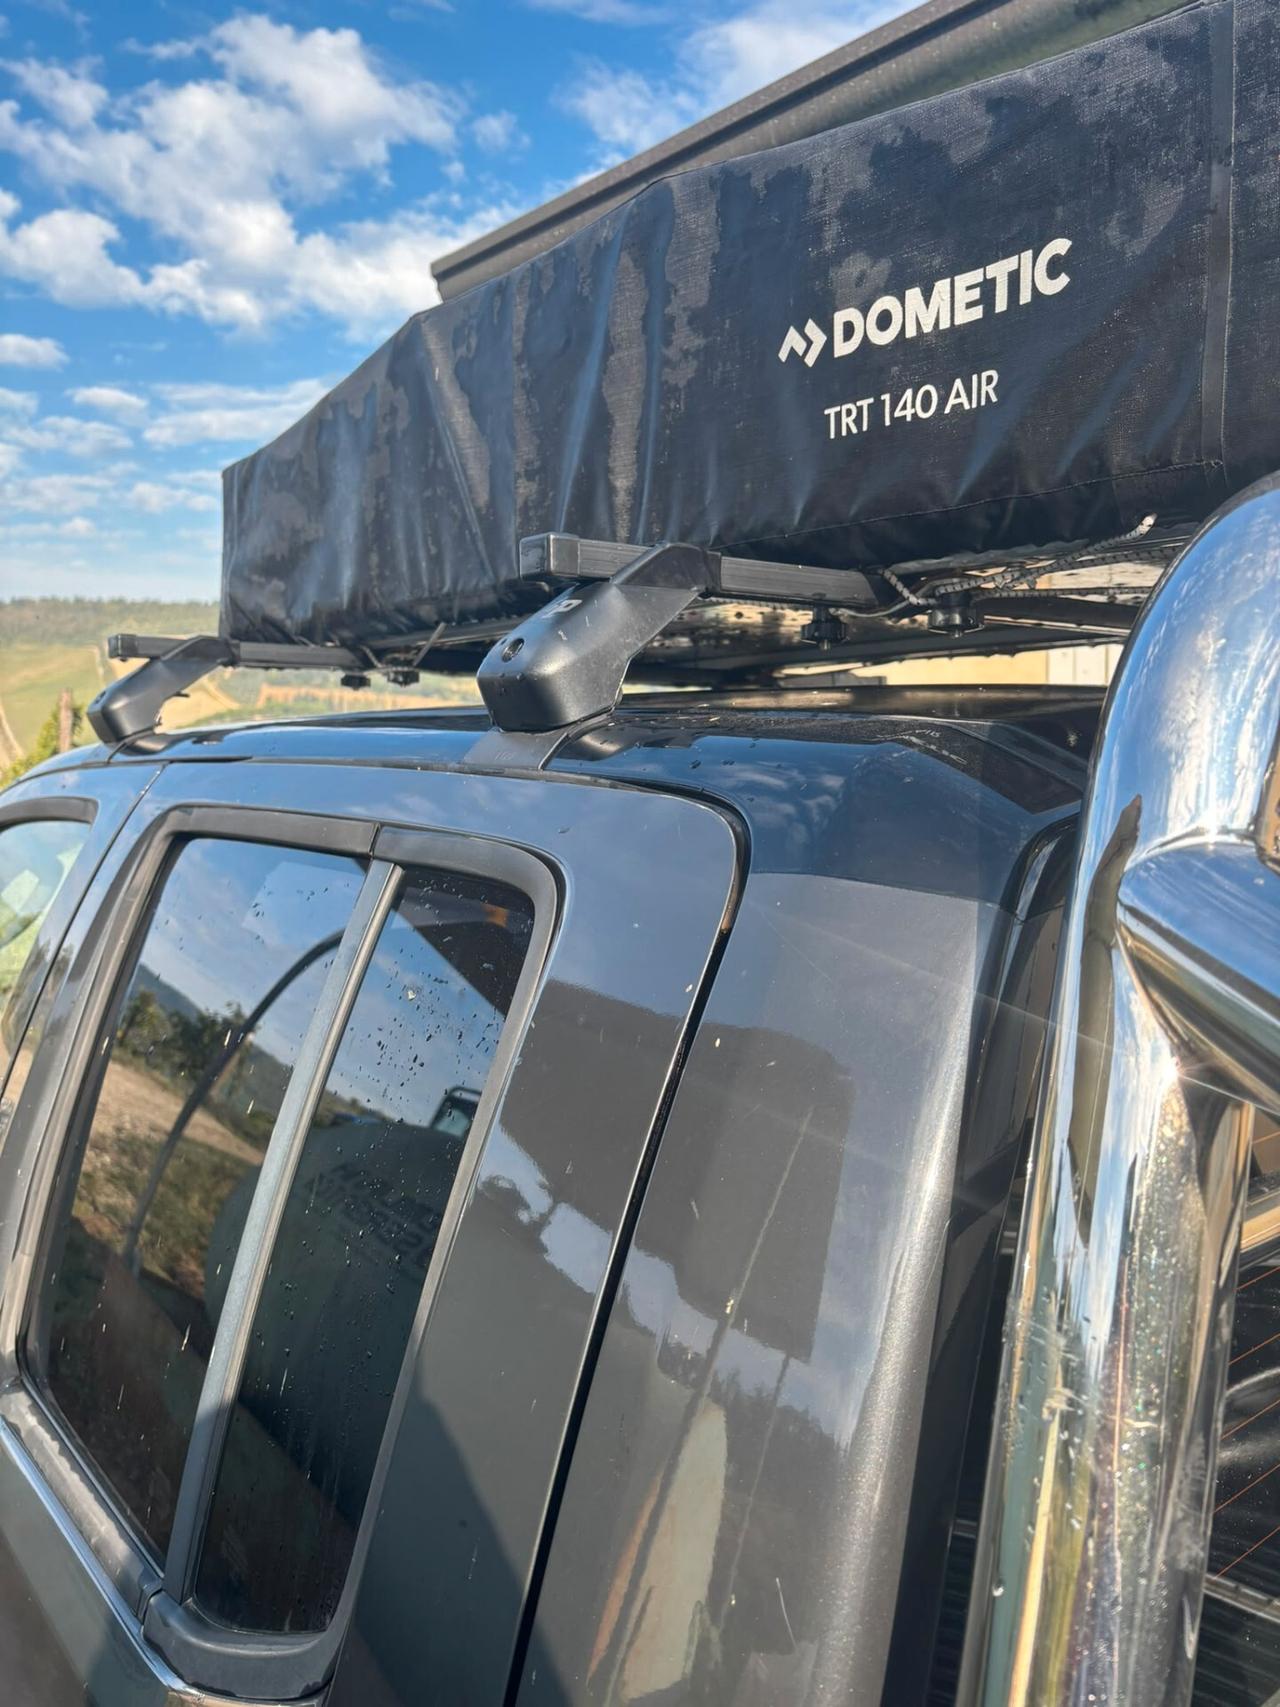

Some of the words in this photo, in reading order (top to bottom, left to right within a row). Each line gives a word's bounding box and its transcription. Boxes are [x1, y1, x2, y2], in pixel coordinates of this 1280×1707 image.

[833, 237, 1073, 358] DOMETIC
[823, 397, 875, 440] TRT
[880, 383, 939, 427] 140
[943, 369, 999, 415] AIR
